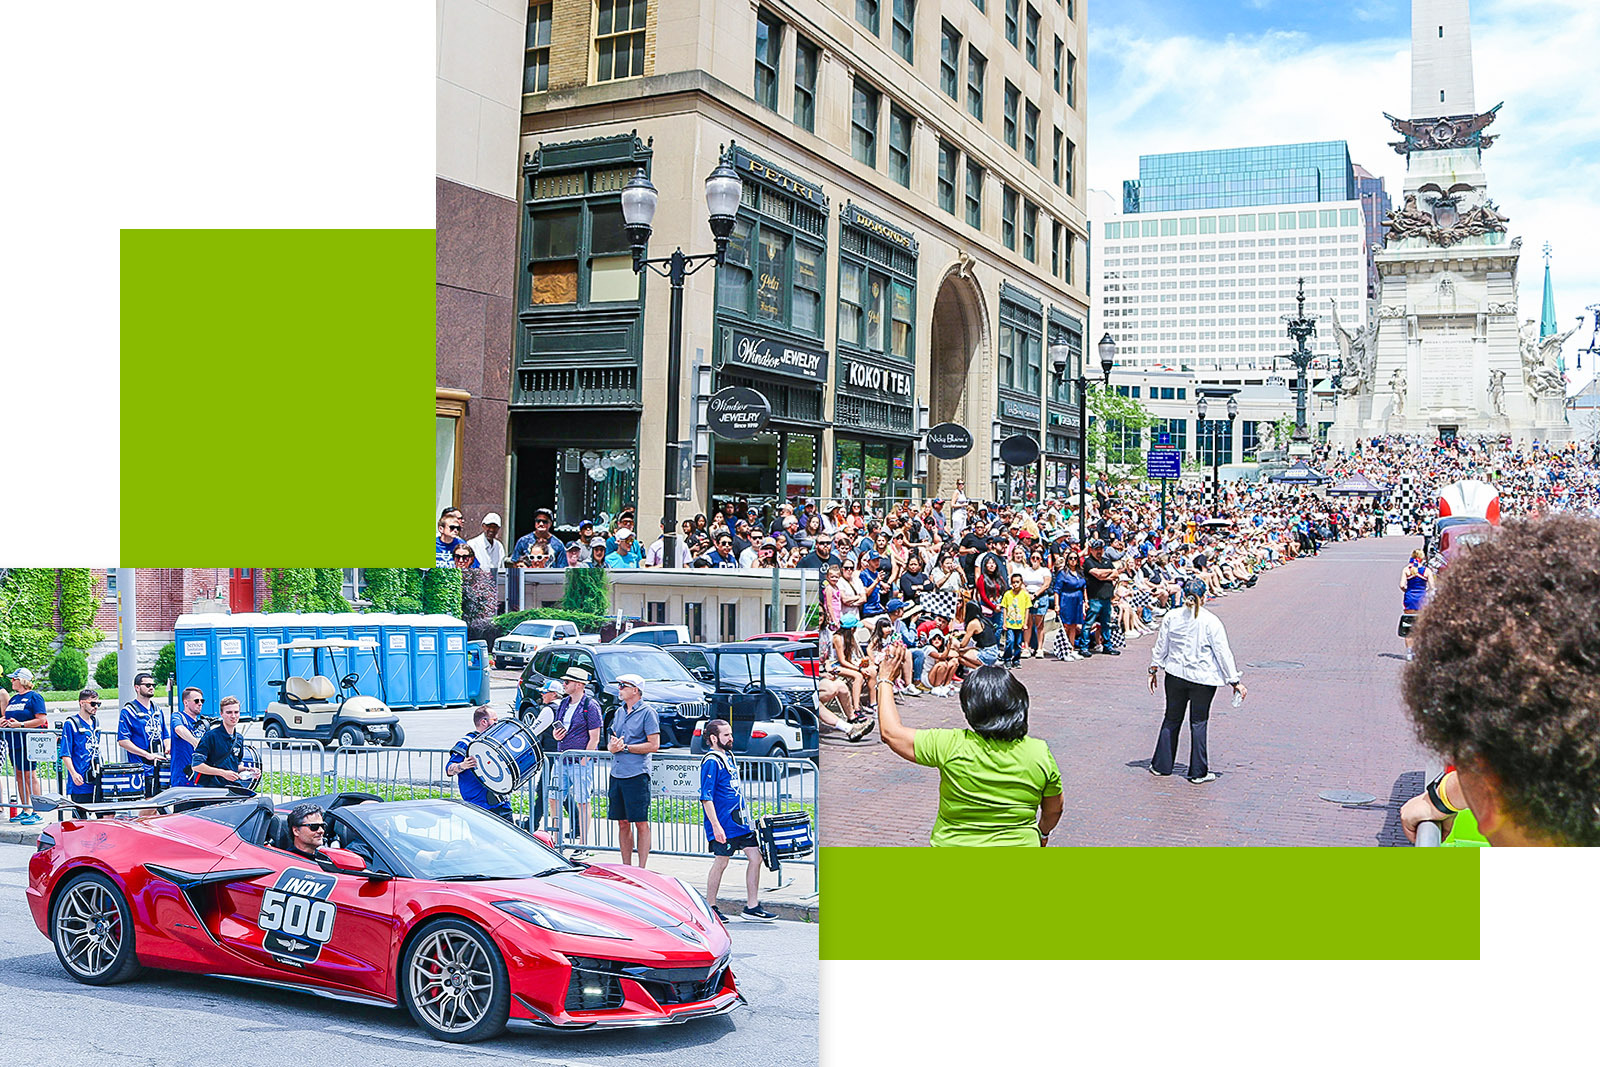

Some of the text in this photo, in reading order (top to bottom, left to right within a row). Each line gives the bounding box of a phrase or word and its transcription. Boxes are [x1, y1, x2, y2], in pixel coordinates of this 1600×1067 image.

[749, 160, 813, 200] PETRI
[857, 214, 910, 247] DIAMONDS
[737, 337, 821, 370] Windsor JEWELRY
[849, 361, 911, 397] KOKO TEA
[711, 396, 749, 412] Windsor
[718, 412, 761, 423] JEWELRY
[665, 764, 700, 772] PROPERTY
[673, 779, 693, 787] D.P.W.
[281, 877, 327, 897] INDY
[259, 889, 336, 942] 500
